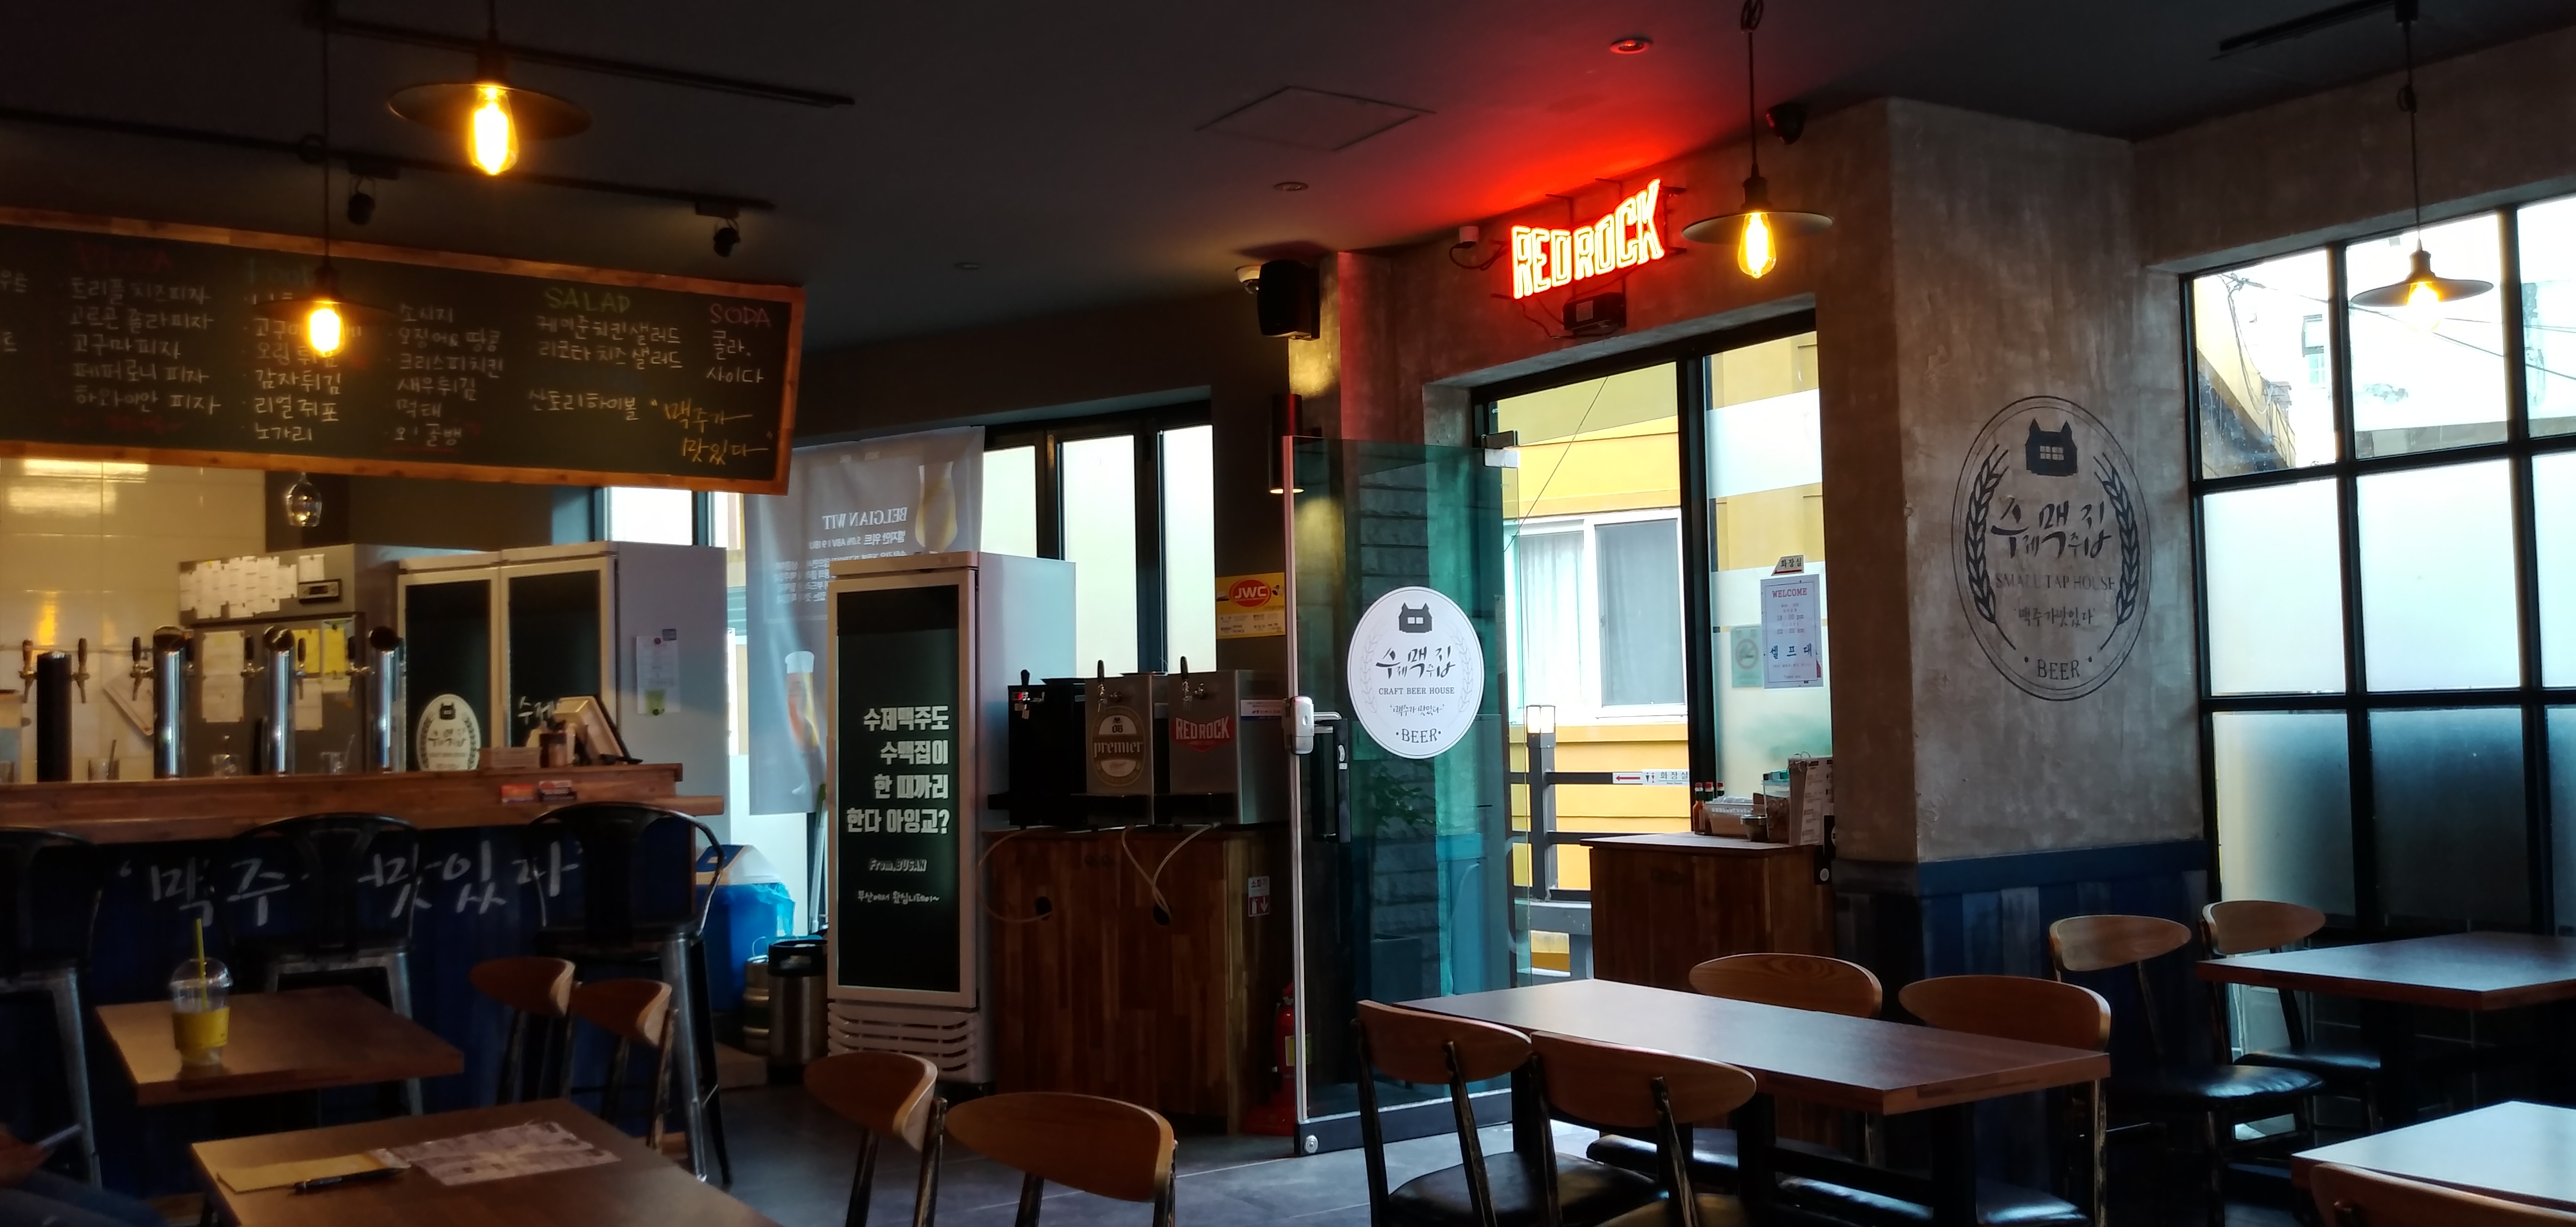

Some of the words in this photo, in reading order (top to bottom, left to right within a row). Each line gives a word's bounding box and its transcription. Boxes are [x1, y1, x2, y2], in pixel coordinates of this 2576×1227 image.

[545, 287, 631, 314] SALAD
[710, 303, 771, 328] SODA
[164, 366, 210, 384] 피자
[706, 366, 764, 384] 사이다
[169, 394, 222, 415] 피자
[254, 423, 313, 441] 노가리
[1780, 557, 1802, 568] 화장실
[1234, 585, 1267, 599] JWC
[1772, 587, 1807, 598] WELCOME
[2036, 658, 2081, 681] BEER
[1378, 687, 1404, 695] CRAFT
[1406, 687, 1427, 695] BEER
[1428, 686, 1455, 695] HOUSE
[862, 705, 950, 732] 수제맥주도
[1401, 728, 1438, 743] BEER
[880, 740, 949, 766] 수맥집이
[1093, 741, 1144, 758] premier
[874, 773, 893, 799] 한
[846, 807, 882, 834] 한다
